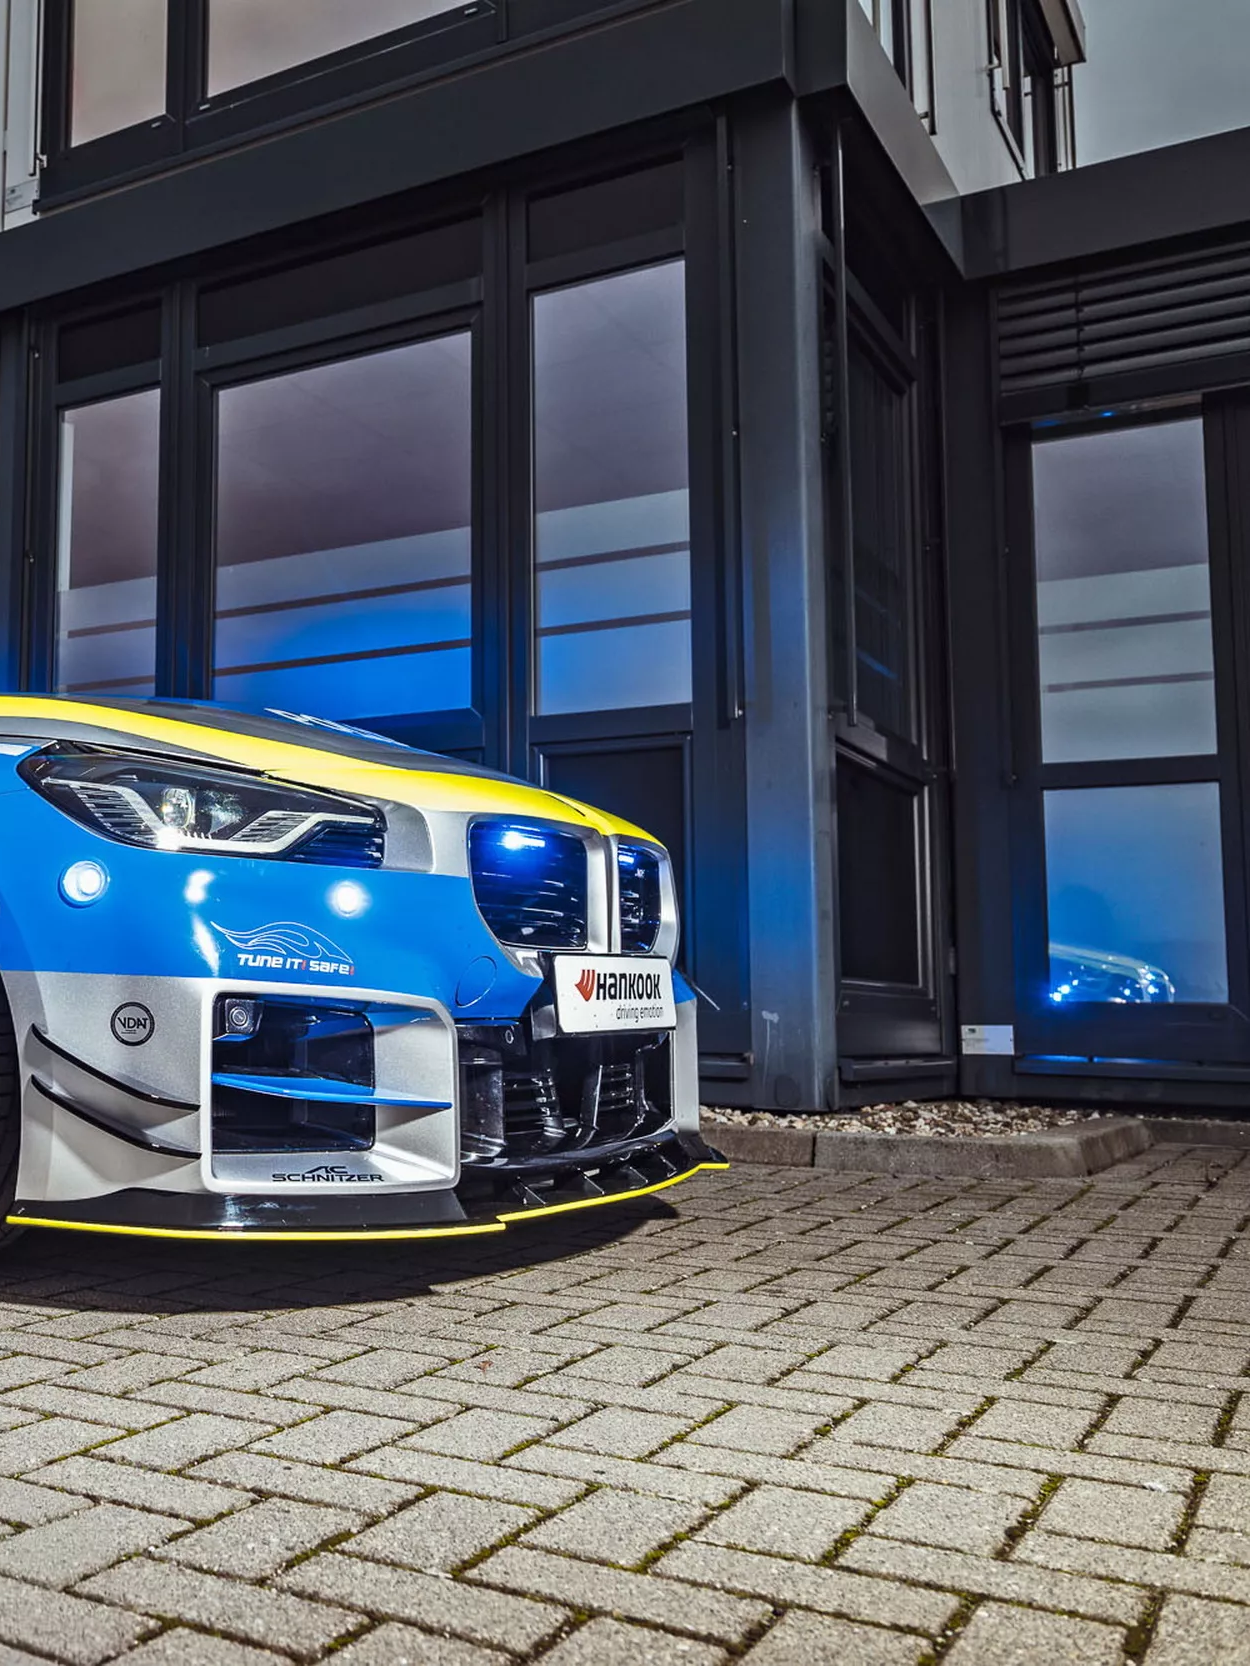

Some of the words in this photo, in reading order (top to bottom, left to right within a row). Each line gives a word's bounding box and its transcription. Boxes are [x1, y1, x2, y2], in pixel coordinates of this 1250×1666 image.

[616, 1004, 639, 1023] driving
[640, 1004, 663, 1019] emotion
[117, 1016, 149, 1030] VDAT
[305, 1165, 348, 1175] AC
[272, 1173, 385, 1182] SCHNITZER
